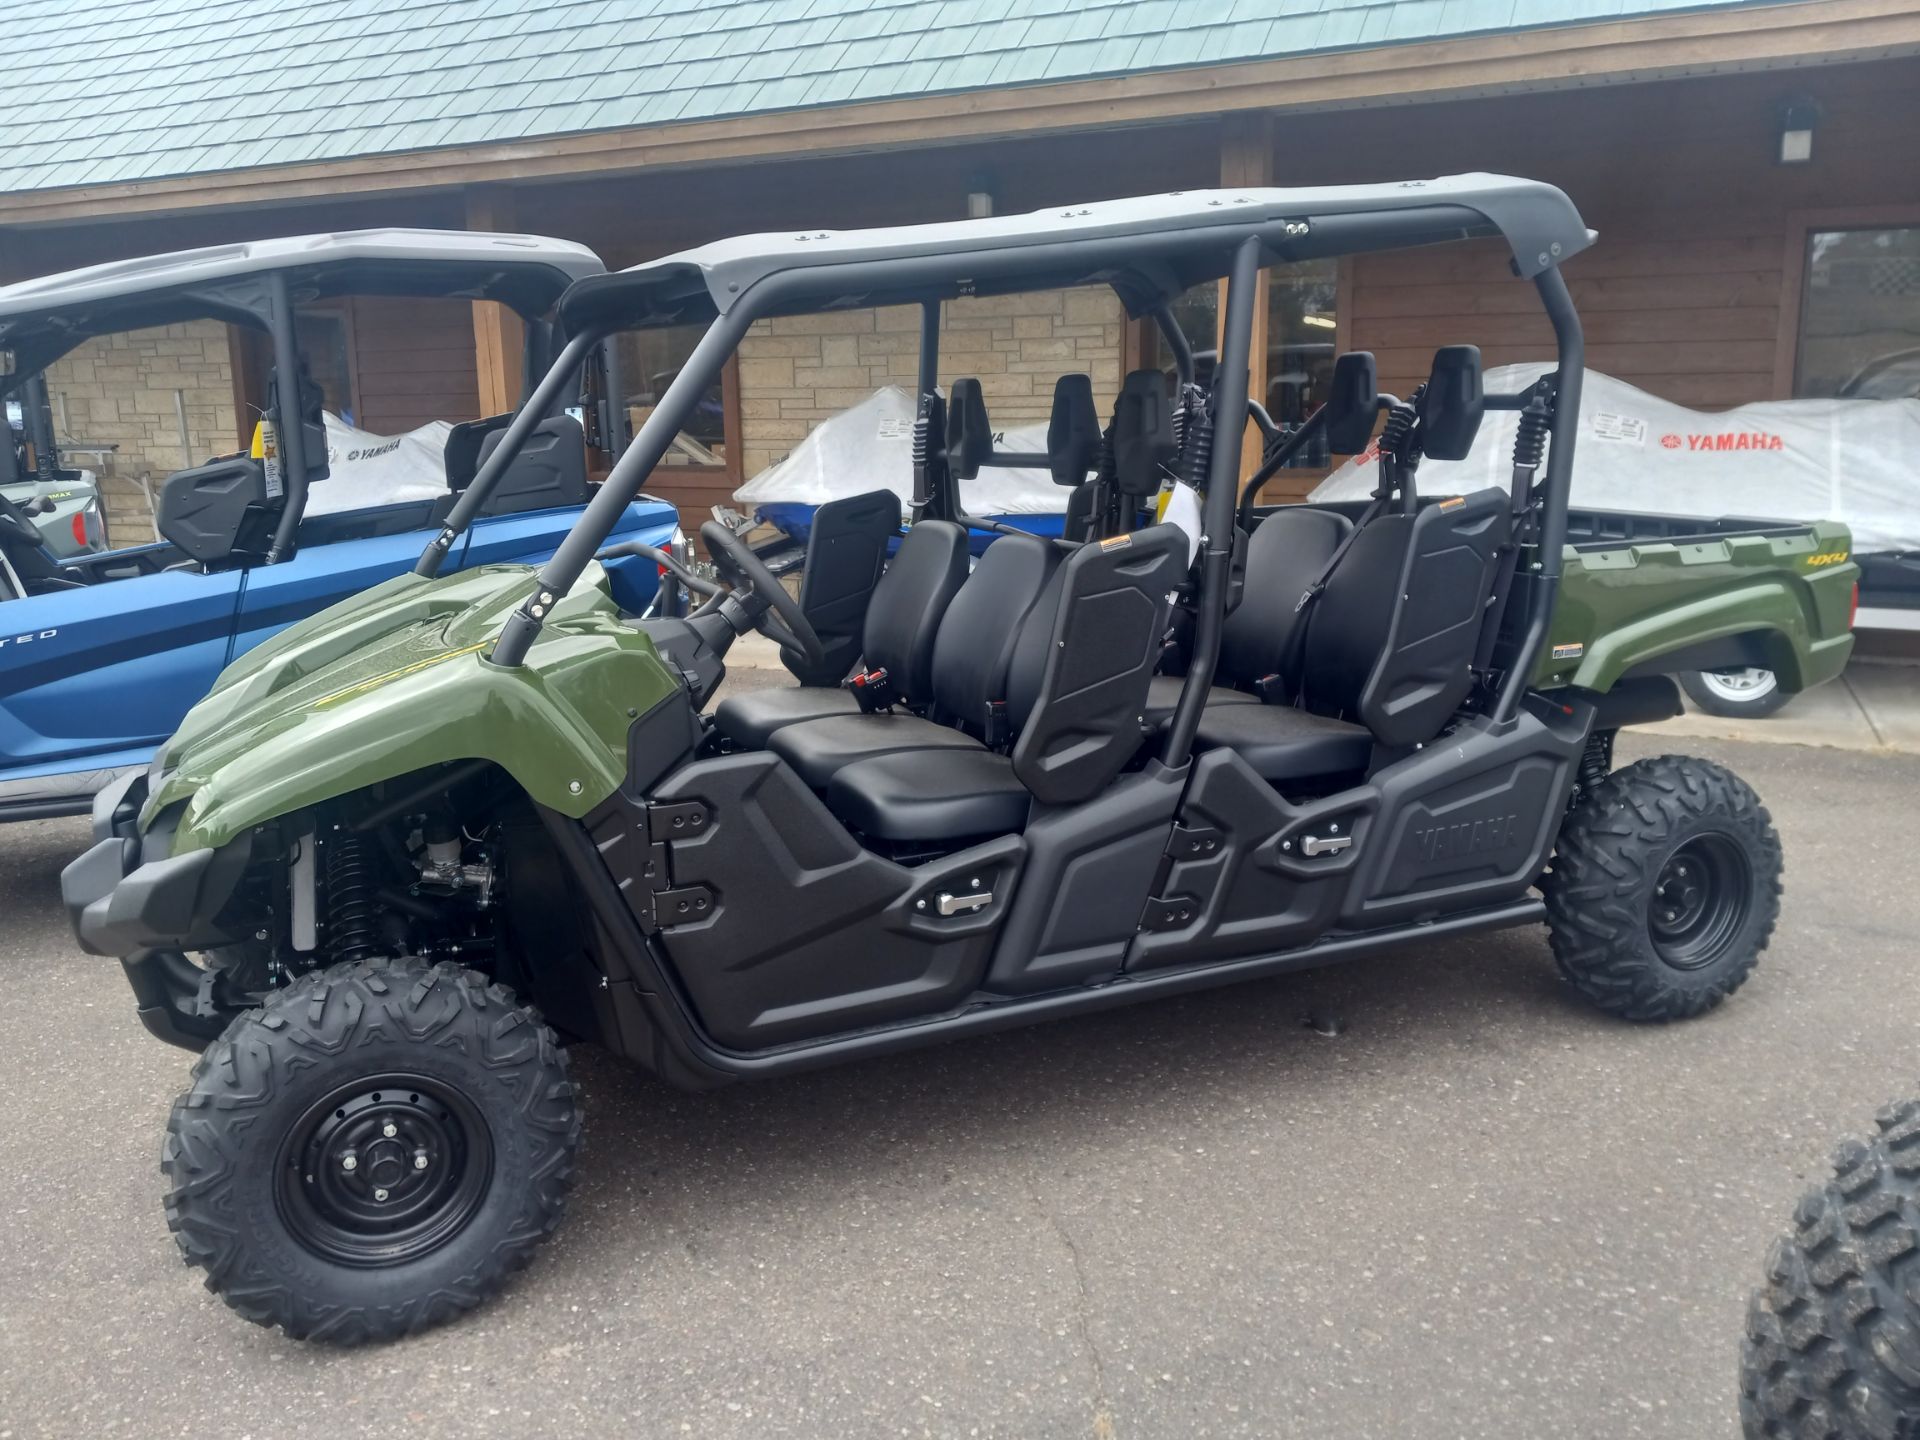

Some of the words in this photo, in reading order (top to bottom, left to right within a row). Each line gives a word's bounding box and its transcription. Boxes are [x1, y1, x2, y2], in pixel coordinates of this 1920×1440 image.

[360, 439, 401, 460] YAMAHA
[1687, 431, 1784, 451] YAMAHA
[1415, 813, 1518, 863] YAMAHA
